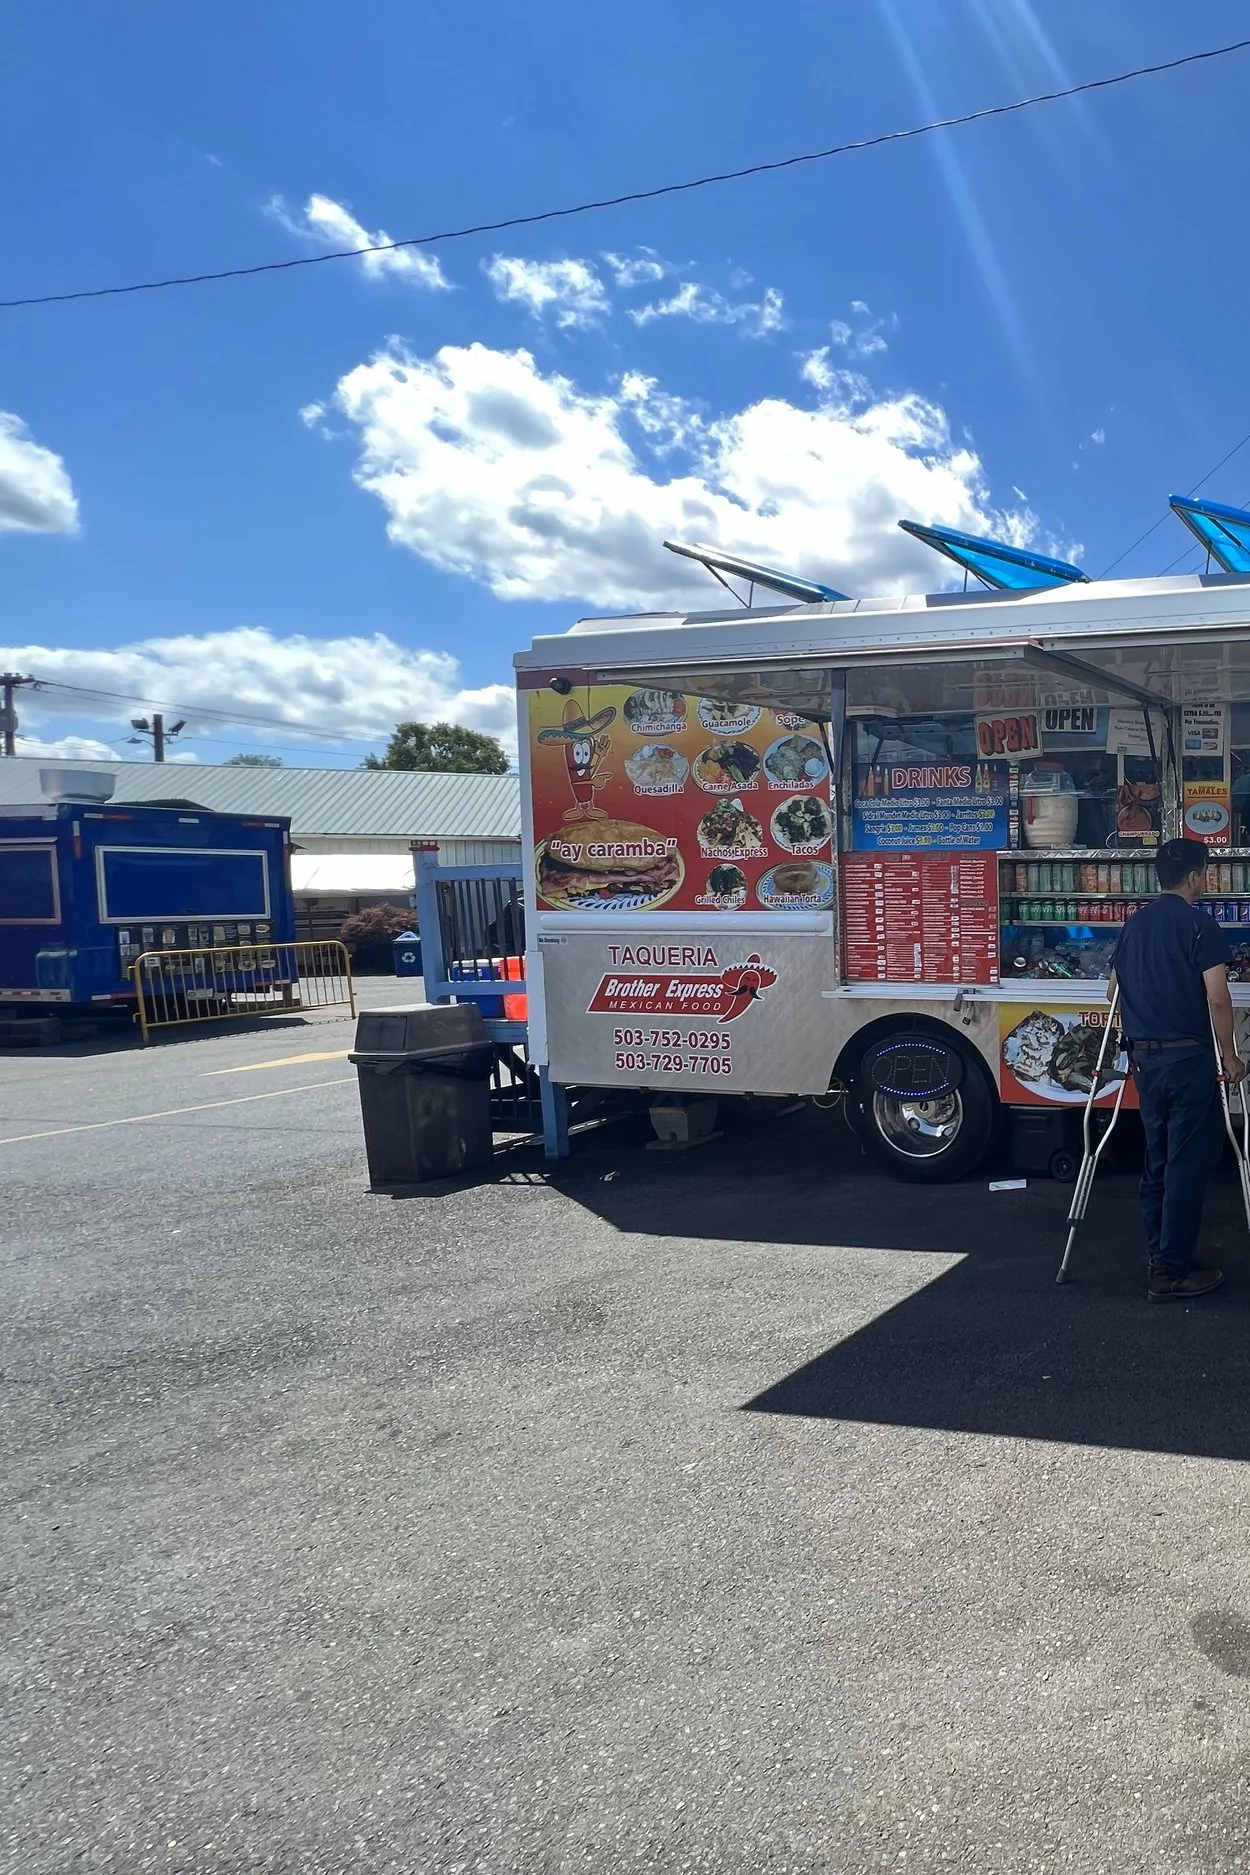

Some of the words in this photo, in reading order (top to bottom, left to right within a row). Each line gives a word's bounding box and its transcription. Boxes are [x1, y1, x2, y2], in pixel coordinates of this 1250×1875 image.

[701, 718, 753, 729] Guacamole
[1045, 707, 1094, 731] OPEN
[631, 721, 687, 733] Chimichanga
[978, 715, 1038, 756] OPEN
[892, 766, 972, 789] DRINKS
[634, 784, 685, 795] Quesadilla
[702, 783, 729, 792] Carne
[731, 781, 758, 791] Asada
[768, 781, 814, 790] Enchiladas
[1187, 788, 1228, 796] TAMALES
[1203, 836, 1228, 844] $3.00
[701, 846, 732, 858] Nachos
[734, 846, 768, 860] Express
[791, 844, 819, 856] Tacos
[695, 894, 720, 905] Grilled
[721, 895, 746, 905] Chiles
[763, 892, 799, 904] Hawaiian
[801, 893, 822, 904] Torta
[608, 945, 719, 968] TAQUERIA
[605, 978, 660, 998] Brother
[665, 978, 724, 1002] Express
[608, 1000, 673, 1011] MEXICAN
[682, 1001, 722, 1012] FOOD
[613, 1028, 731, 1050] 503-752-0295
[615, 1052, 732, 1075] 503-729-7705
[872, 1053, 951, 1085] OPEN
